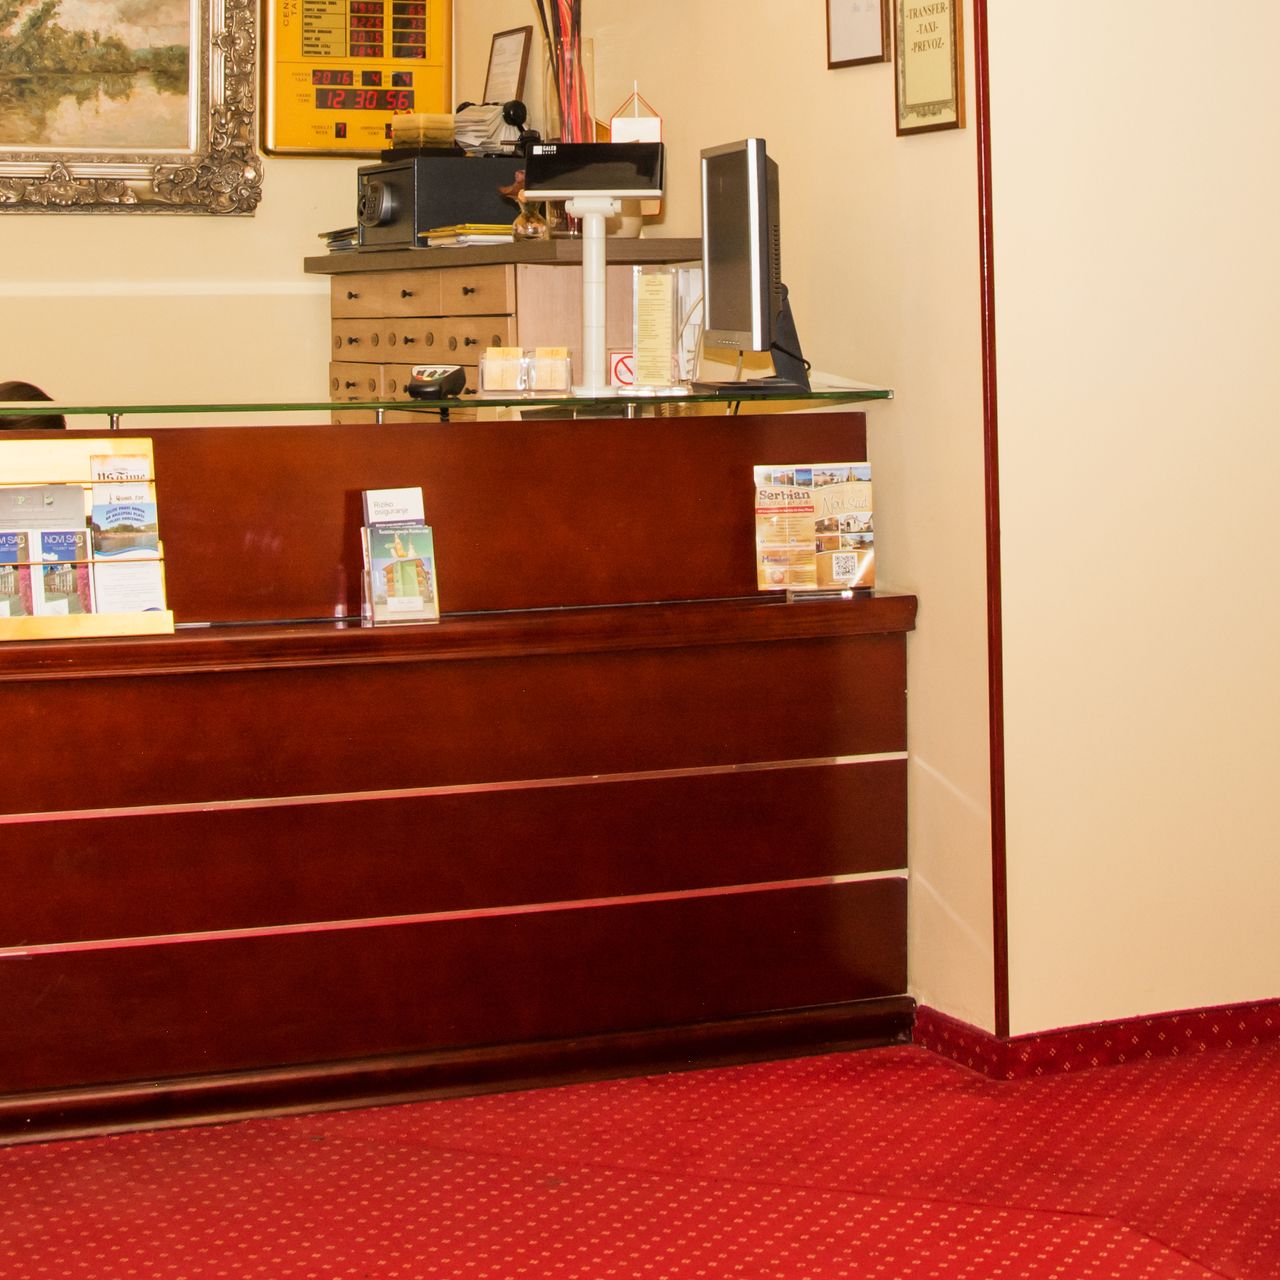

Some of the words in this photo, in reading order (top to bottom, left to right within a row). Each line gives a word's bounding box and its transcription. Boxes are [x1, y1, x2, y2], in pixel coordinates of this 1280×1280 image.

[313, 71, 350, 85] 2016
[328, 89, 345, 108] 12
[354, 90, 378, 109] 30
[386, 90, 409, 109] 56
[759, 489, 811, 500] Serbian
[7, 535, 26, 544] SAD
[44, 535, 65, 544] NOVI
[66, 534, 84, 543] SAD
